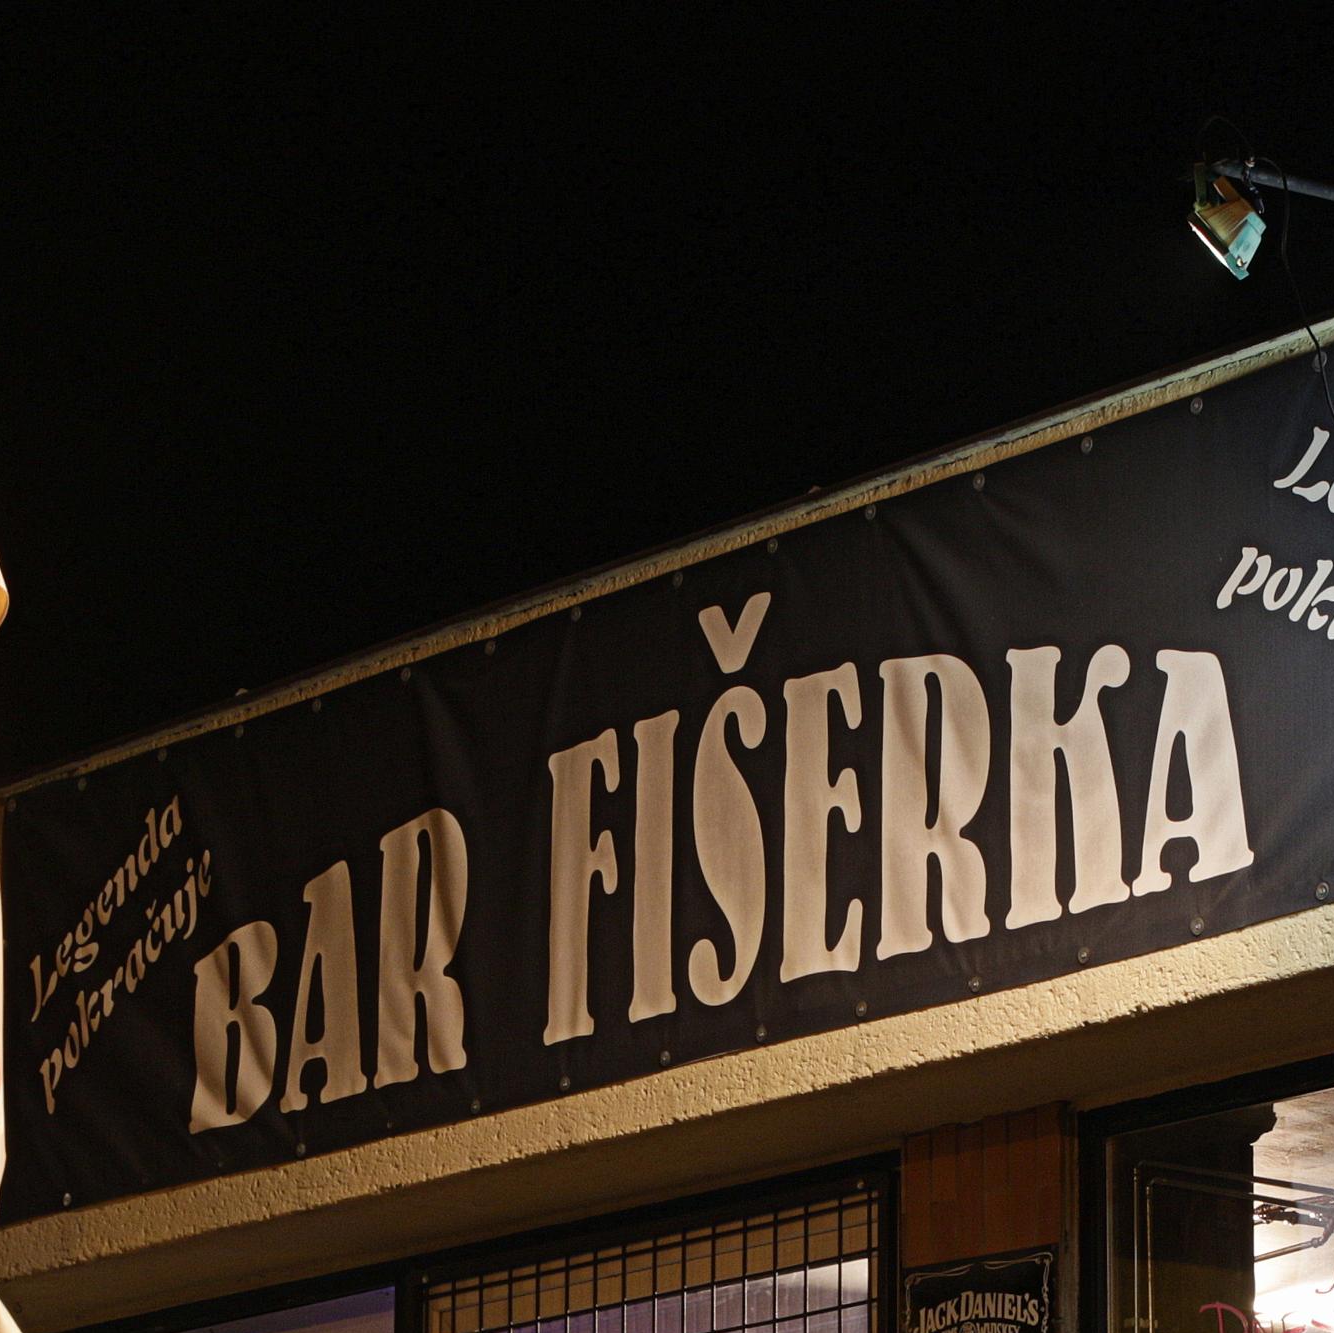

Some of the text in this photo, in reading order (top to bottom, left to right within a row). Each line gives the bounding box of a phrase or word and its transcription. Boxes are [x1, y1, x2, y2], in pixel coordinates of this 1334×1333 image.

[30, 795, 183, 1022] Legenda
[40, 849, 212, 1114] pokračuje
[190, 592, 1254, 1134] BAR FIŠERKA
[958, 1290, 1040, 1327] DANIEL'S
